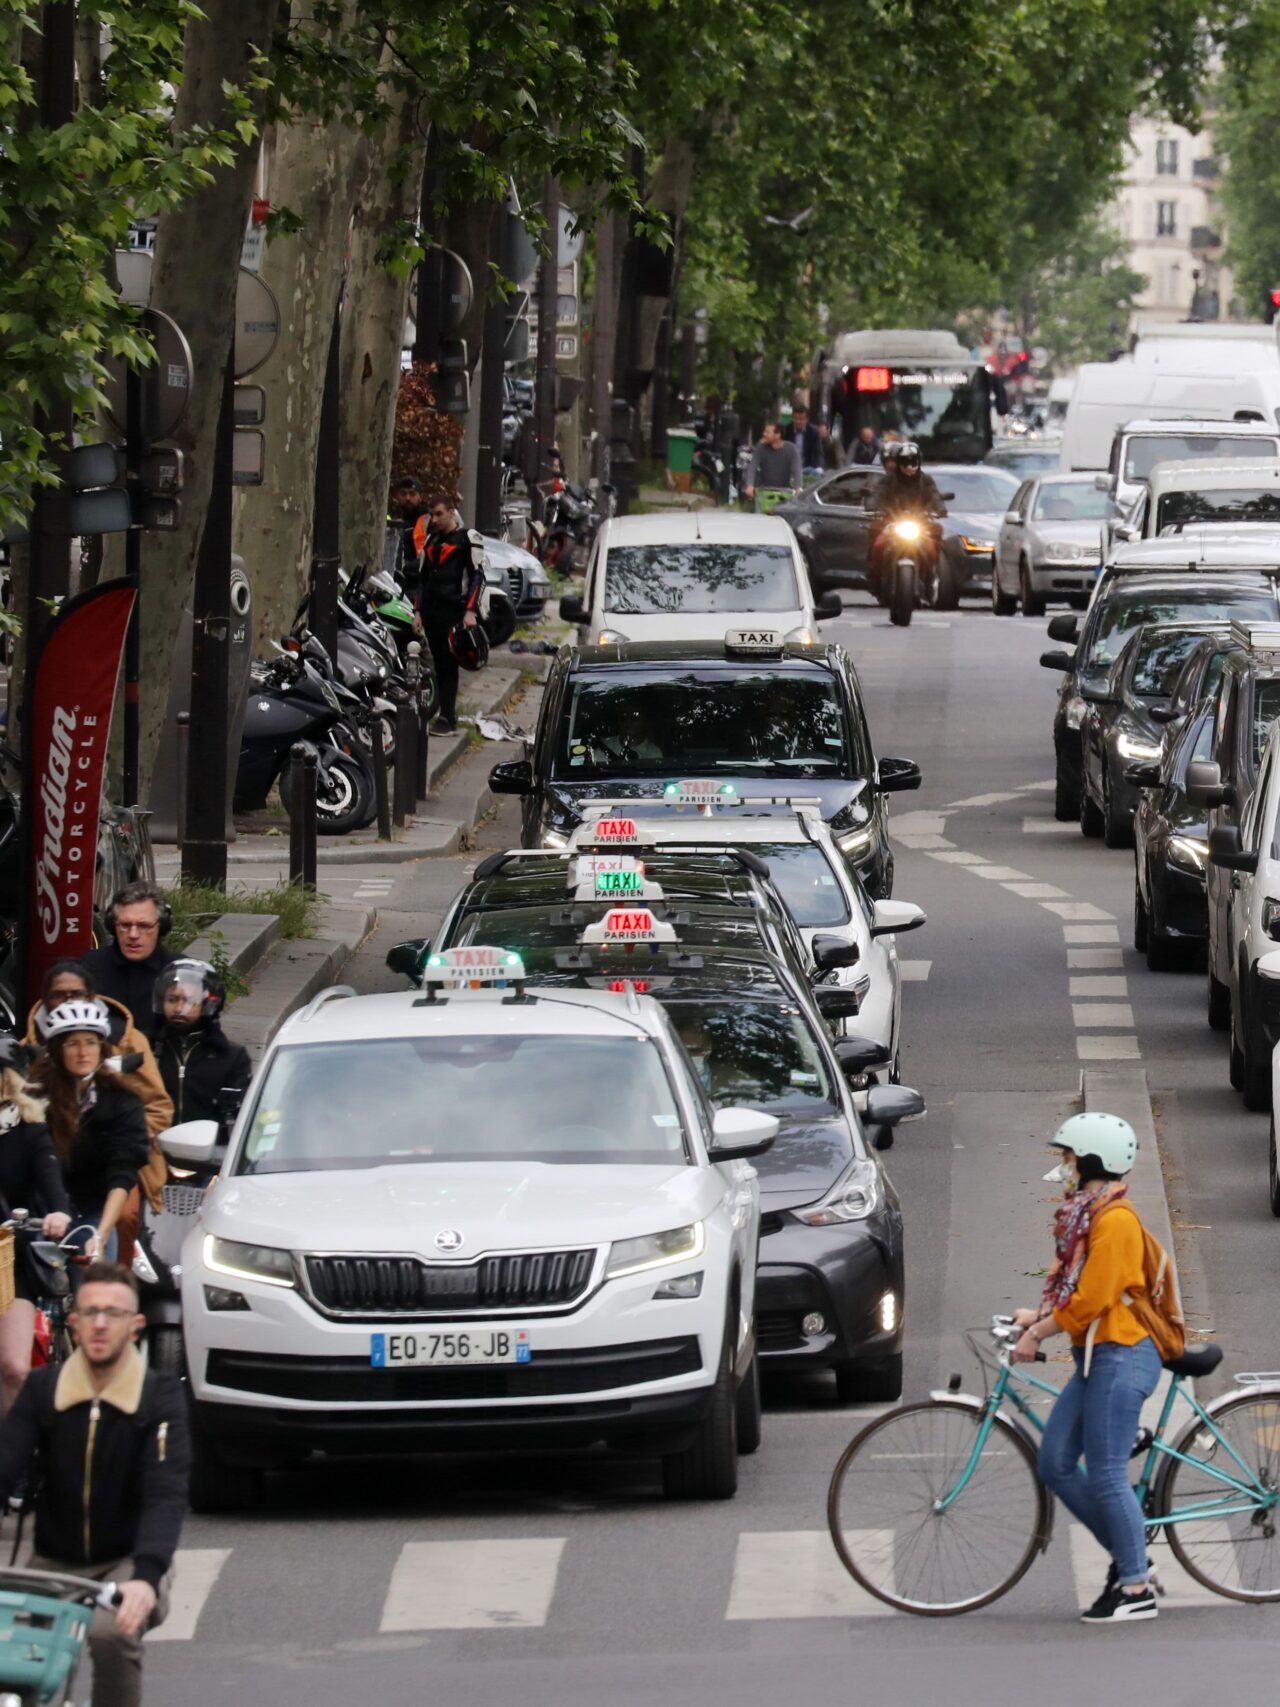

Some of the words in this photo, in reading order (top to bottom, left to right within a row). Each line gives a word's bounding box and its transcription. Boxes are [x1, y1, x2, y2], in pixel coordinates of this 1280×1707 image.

[738, 632, 774, 643] TAXI
[684, 781, 717, 795] TAXI
[679, 795, 722, 803] PARISIEN
[36, 705, 78, 944] Indian
[65, 714, 97, 933] MOTORCYCLE
[600, 821, 634, 835] TAXI
[593, 835, 638, 843] PARISIEN
[588, 861, 623, 872] TAXI
[602, 872, 637, 889] TAXI
[595, 889, 645, 897] PARISIEN
[612, 914, 649, 930] TAXI
[604, 931, 656, 939] PARISIEN
[453, 950, 493, 966] TAXI
[451, 967, 505, 976] PARISIEN
